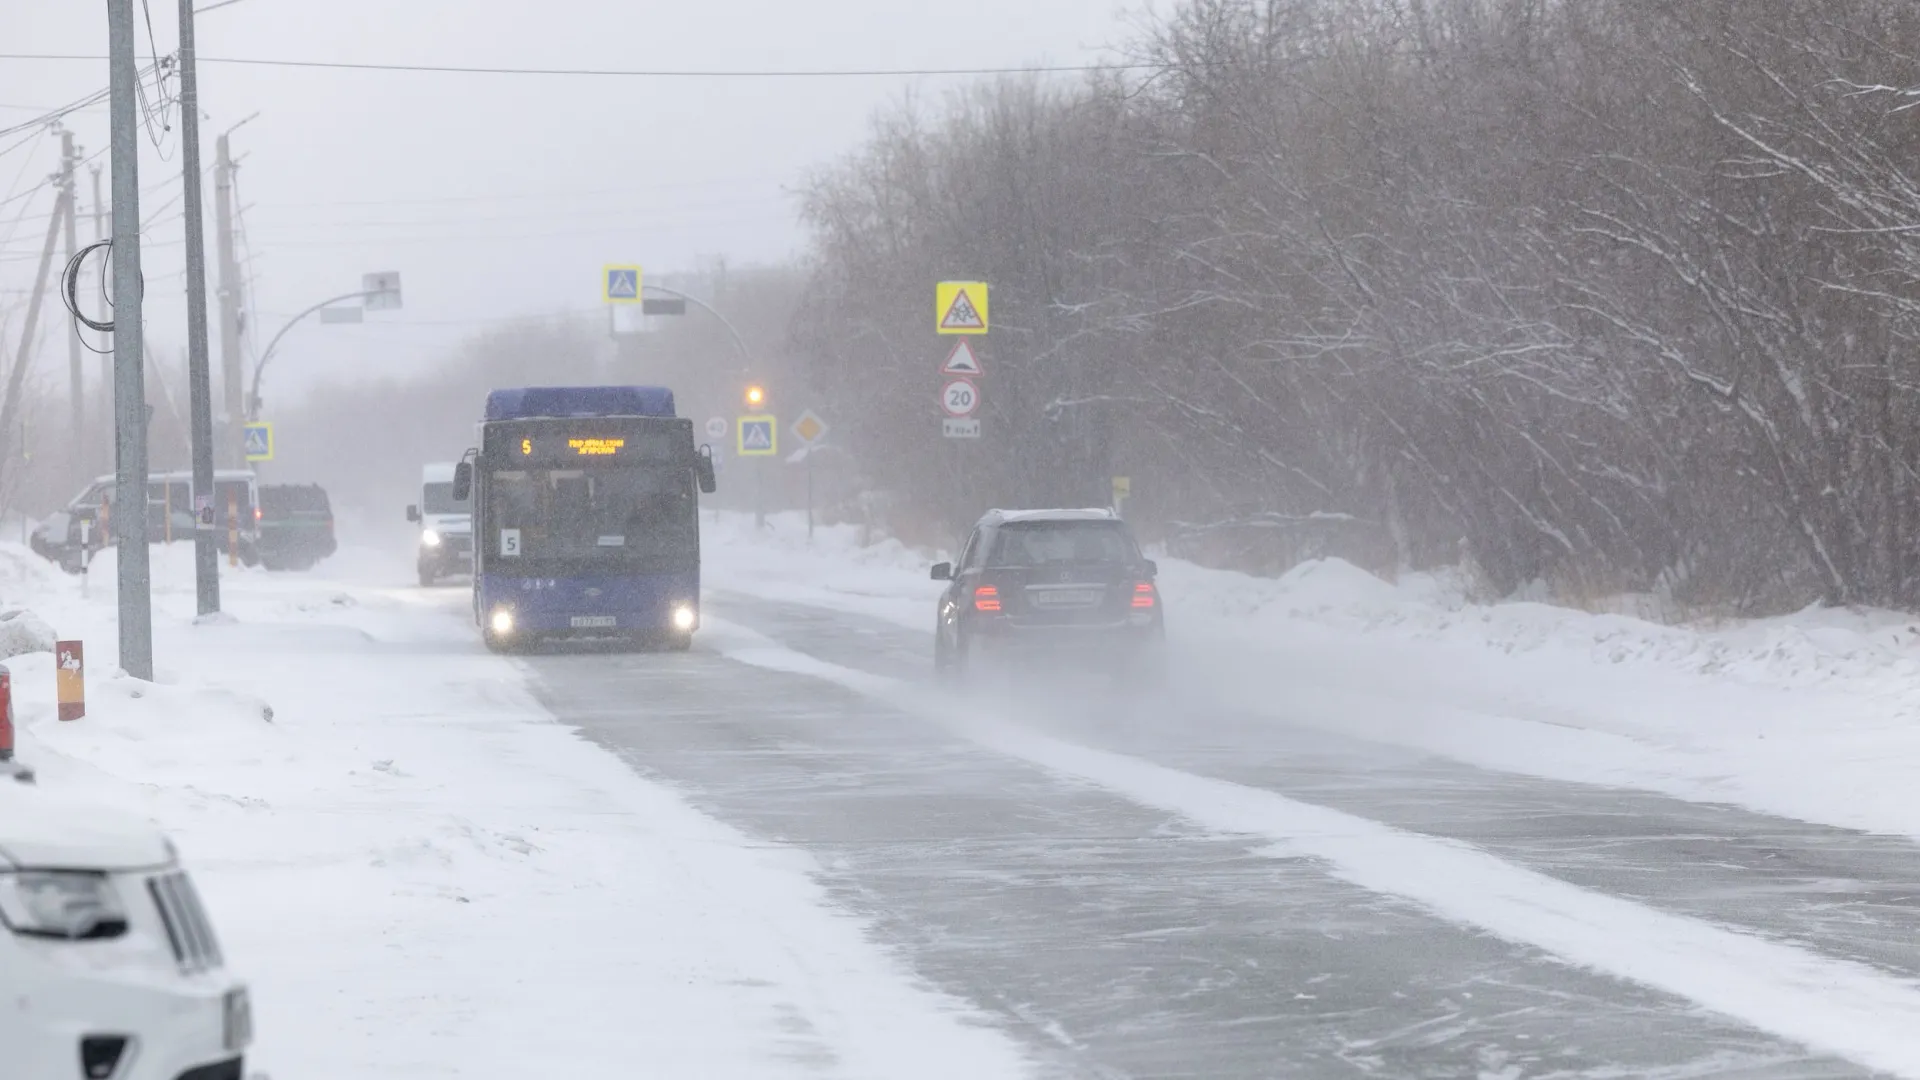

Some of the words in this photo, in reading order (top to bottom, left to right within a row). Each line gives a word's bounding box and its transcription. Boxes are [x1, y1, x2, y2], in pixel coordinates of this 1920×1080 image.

[950, 390, 971, 406] 20
[522, 439, 532, 455] 5
[507, 537, 516, 551] 5
